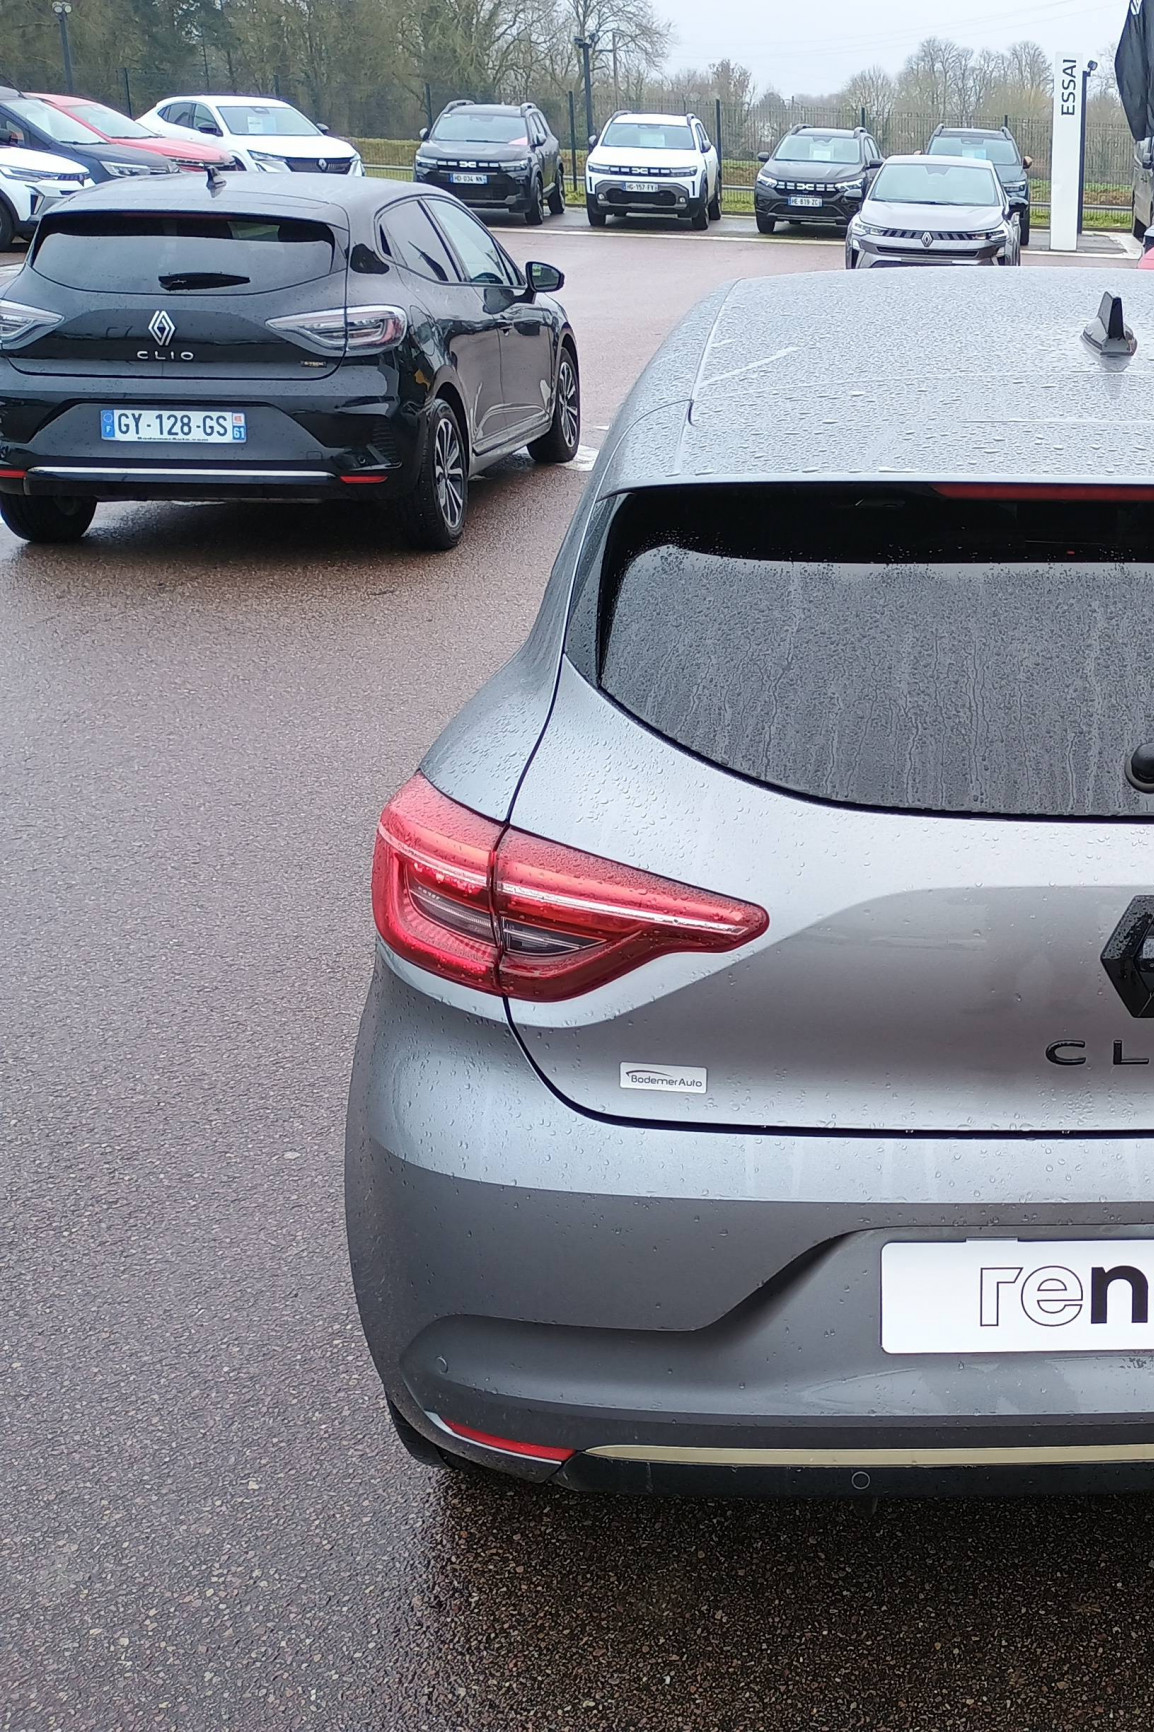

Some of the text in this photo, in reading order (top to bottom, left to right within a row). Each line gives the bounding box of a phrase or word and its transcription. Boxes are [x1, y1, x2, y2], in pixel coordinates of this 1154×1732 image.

[1061, 59, 1077, 116] ESSAI
[137, 351, 194, 360] CLIO
[233, 427, 245, 439] 61
